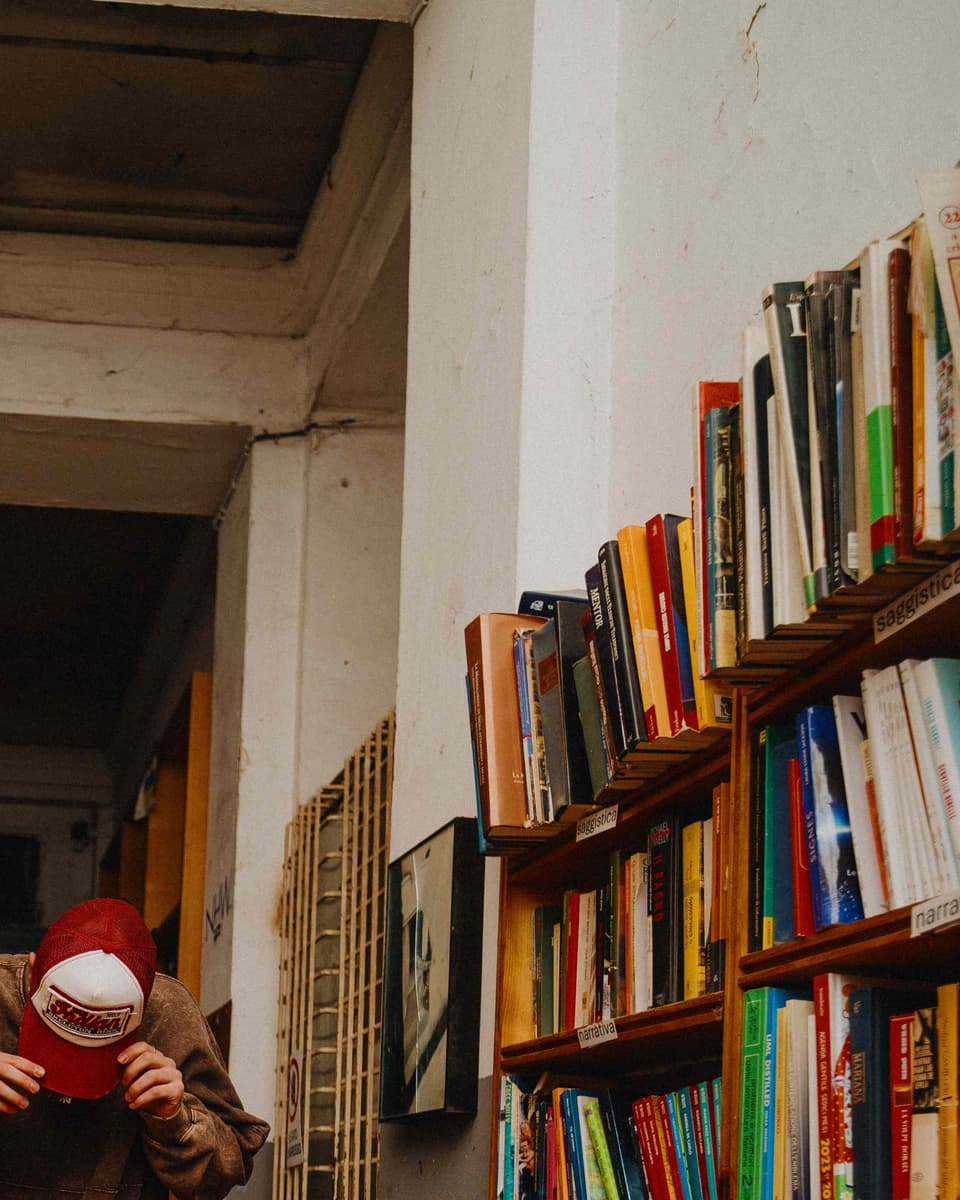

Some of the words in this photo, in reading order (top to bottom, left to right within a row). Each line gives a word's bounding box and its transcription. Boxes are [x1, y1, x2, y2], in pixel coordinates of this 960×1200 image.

[590, 587, 603, 630] MENTOR
[877, 565, 960, 632] saggistica
[577, 809, 618, 837] saggistica
[807, 809, 817, 863] SIGNES
[579, 1022, 616, 1042] narrativa
[853, 1053, 864, 1104] MARIANA
[820, 1138, 831, 1173] 2023
